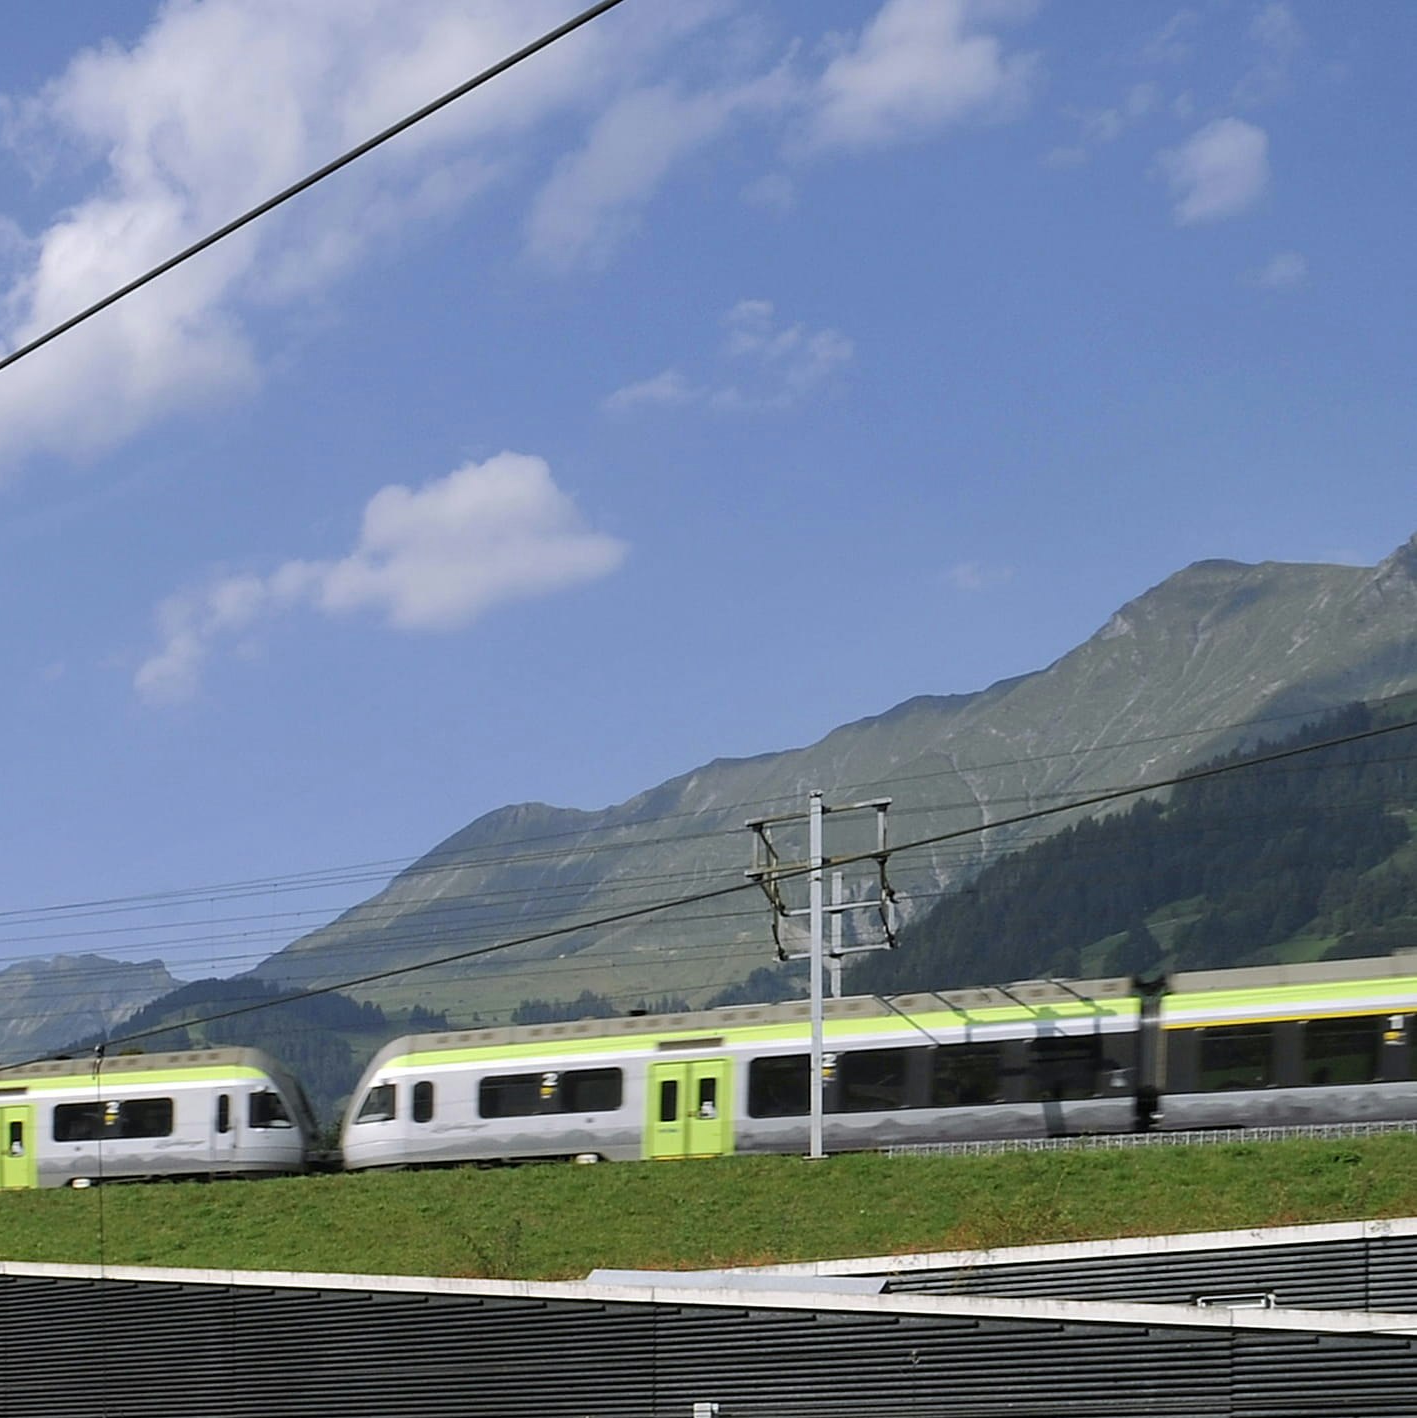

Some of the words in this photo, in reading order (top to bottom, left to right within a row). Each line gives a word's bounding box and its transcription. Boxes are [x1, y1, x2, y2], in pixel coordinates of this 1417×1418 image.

[822, 1053, 837, 1067] 2
[542, 1072, 557, 1086] 2
[105, 1101, 119, 1114] 2
